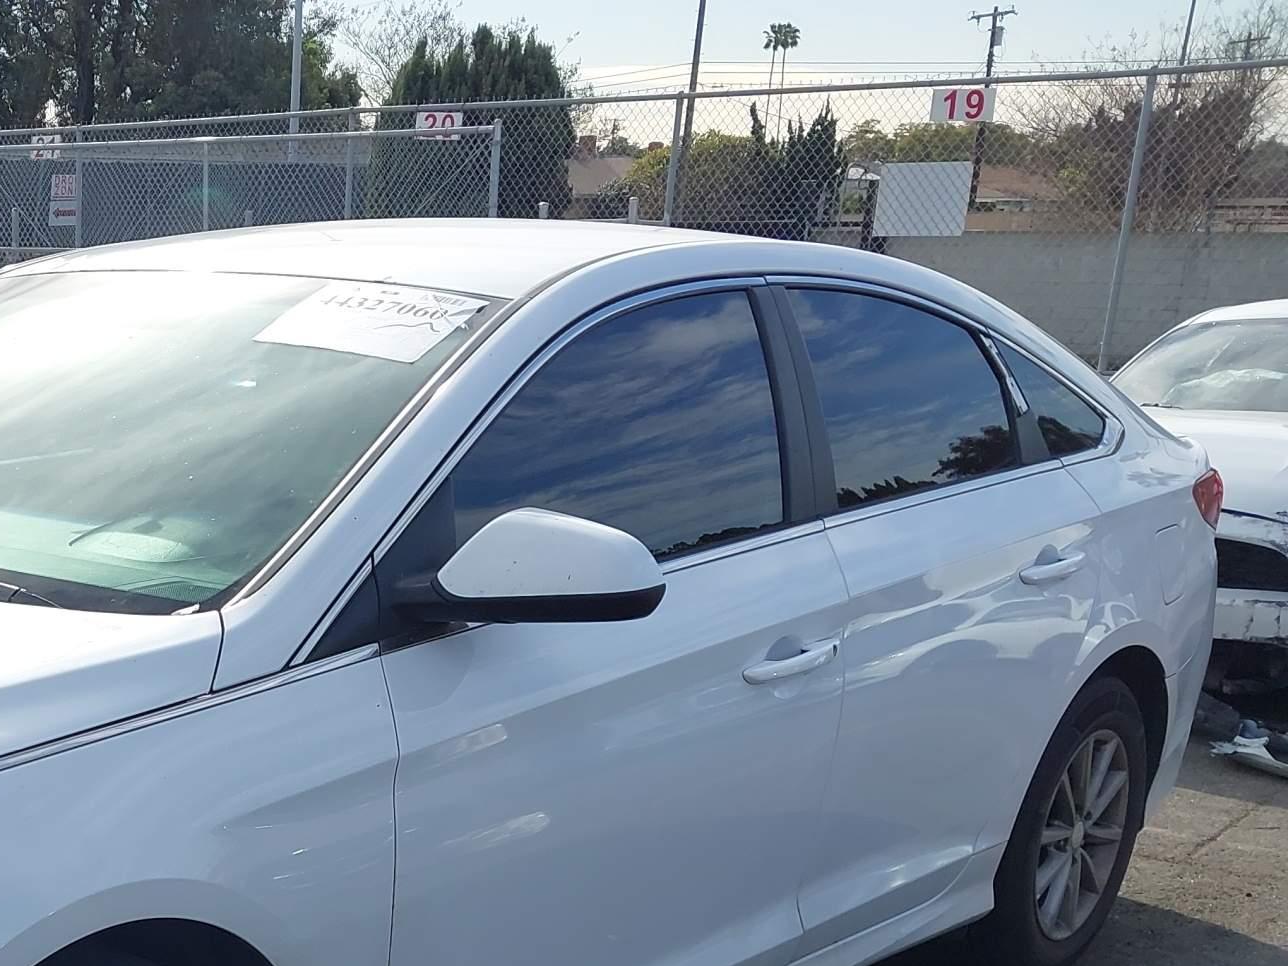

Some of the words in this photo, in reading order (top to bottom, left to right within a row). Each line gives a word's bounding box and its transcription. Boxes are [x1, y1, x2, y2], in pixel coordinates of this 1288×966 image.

[944, 89, 984, 119] 19
[424, 113, 455, 138] 20
[320, 294, 449, 321] 44327060
